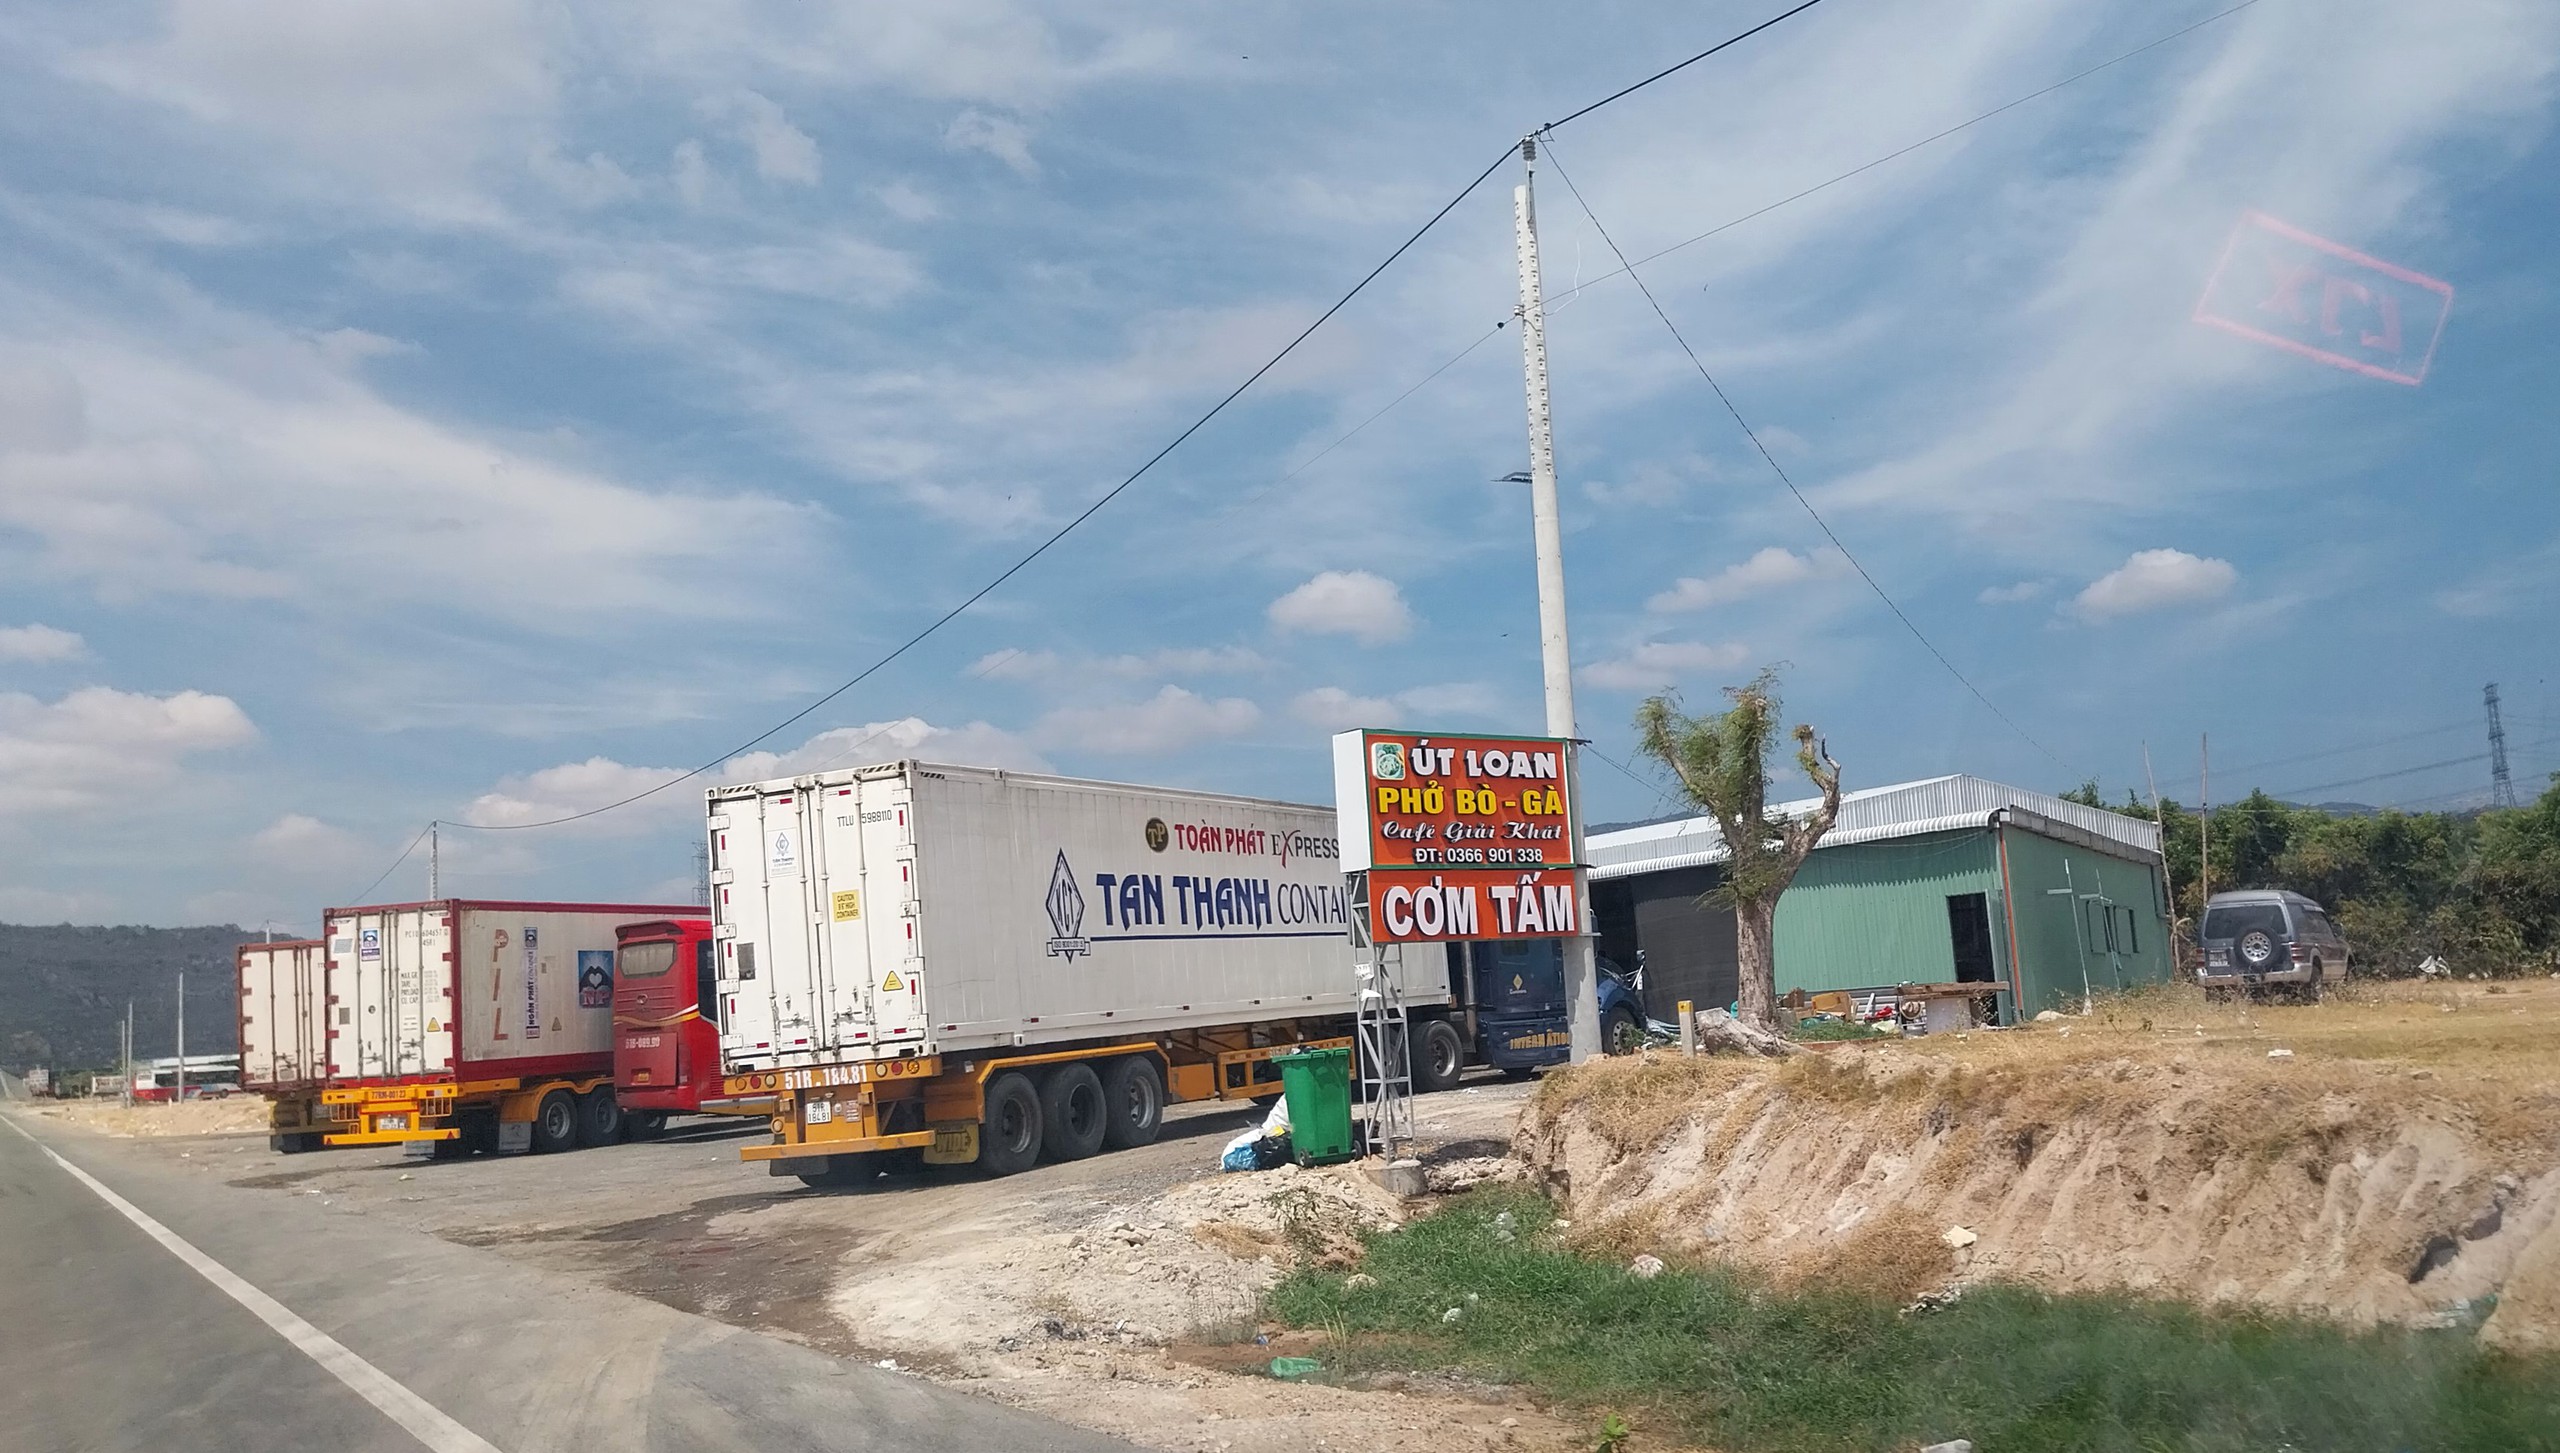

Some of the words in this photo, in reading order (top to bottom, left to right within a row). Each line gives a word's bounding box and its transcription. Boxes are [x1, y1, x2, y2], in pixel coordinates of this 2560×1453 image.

[1411, 740, 1455, 776] ÚT
[1466, 750, 1557, 778] LOAN
[1378, 780, 1445, 814] PHỞ
[1456, 783, 1498, 815] BÒ
[1522, 784, 1564, 815] GÀ
[837, 815, 854, 827] TTLU
[862, 809, 893, 823] 5988110
[1383, 821, 1436, 842] Café
[1504, 822, 1562, 840] Khát
[1174, 819, 1223, 854] TOÀN
[1225, 824, 1266, 856] PHÁT
[1416, 848, 1443, 863] ĐT:
[1447, 848, 1483, 864] 0366
[1488, 849, 1513, 863] 901
[1518, 848, 1543, 864] 338
[836, 909, 859, 919] CONTAINER
[1096, 874, 1165, 932] TAN
[1172, 876, 1273, 932] THANH
[1278, 884, 1347, 924] CONTAI
[1382, 876, 1478, 937] CƠM
[1488, 872, 1575, 934] TẤM
[812, 1102, 826, 1113] 51R
